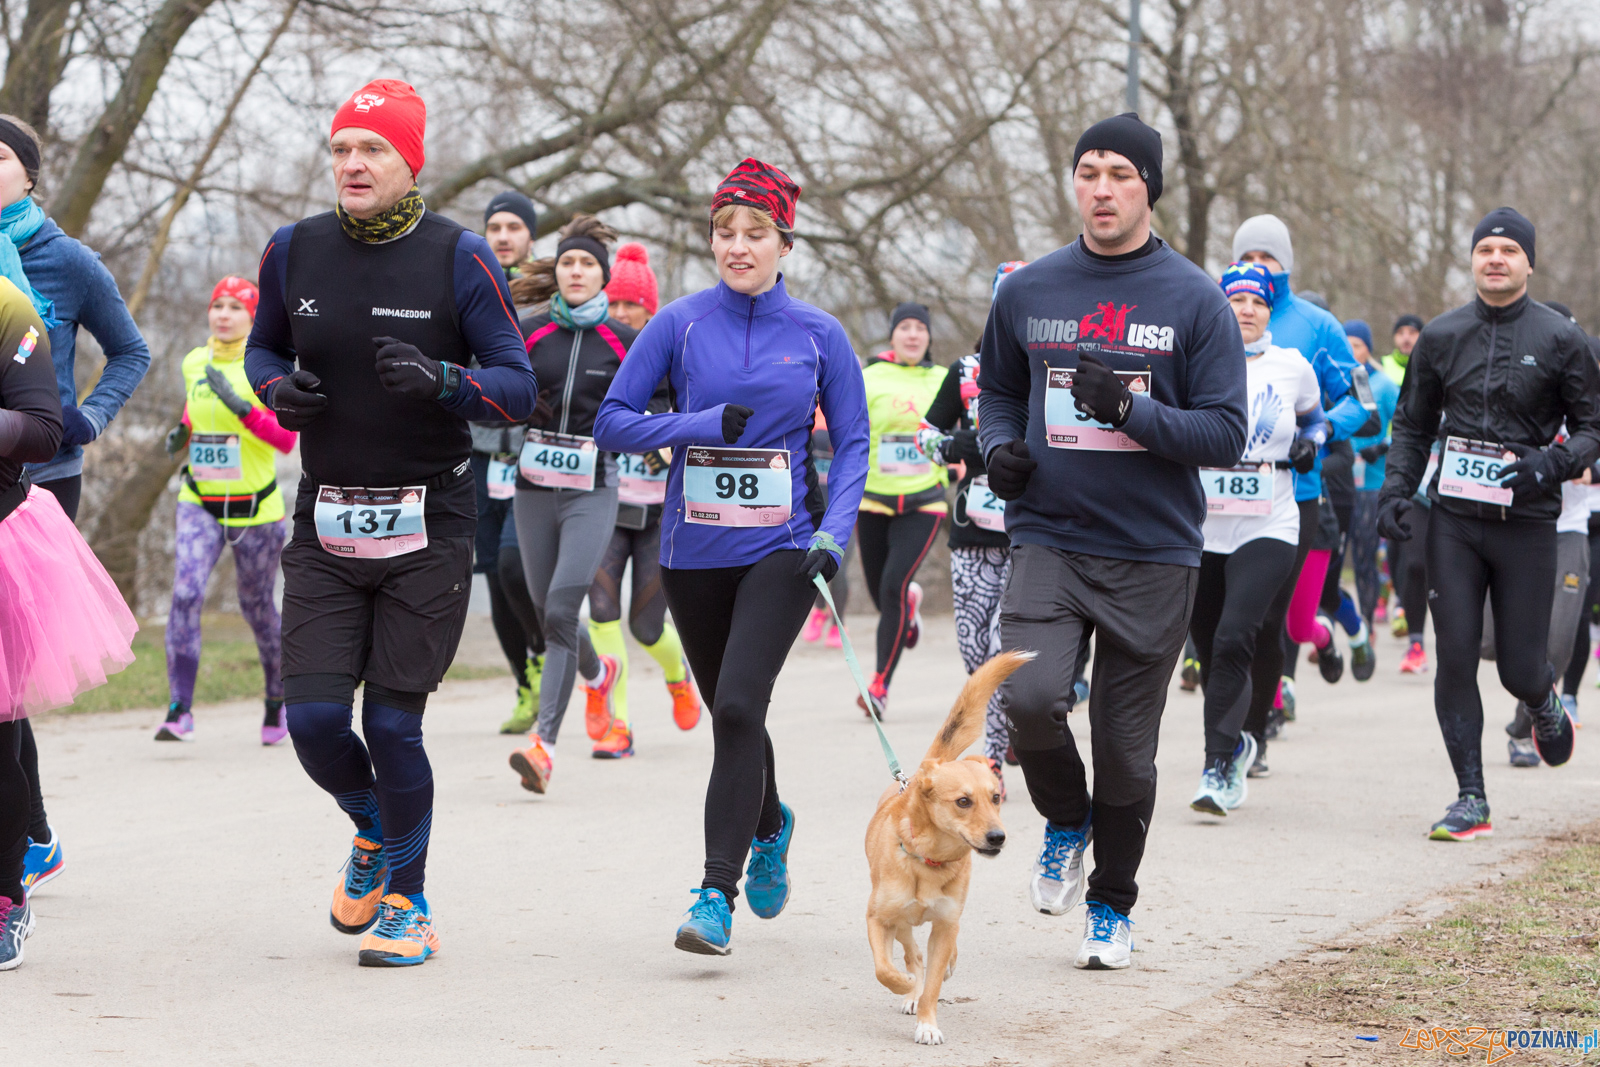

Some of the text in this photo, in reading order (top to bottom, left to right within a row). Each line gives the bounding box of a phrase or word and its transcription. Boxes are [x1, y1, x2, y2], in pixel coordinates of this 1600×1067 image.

[372, 307, 431, 319] RUNMAGEDDON
[1027, 316, 1174, 351] bone usa
[195, 447, 228, 463] 286
[534, 449, 580, 470] 480
[1455, 457, 1502, 482] 356
[715, 473, 759, 499] 98
[1214, 476, 1259, 495] 183
[336, 508, 402, 534] 137
